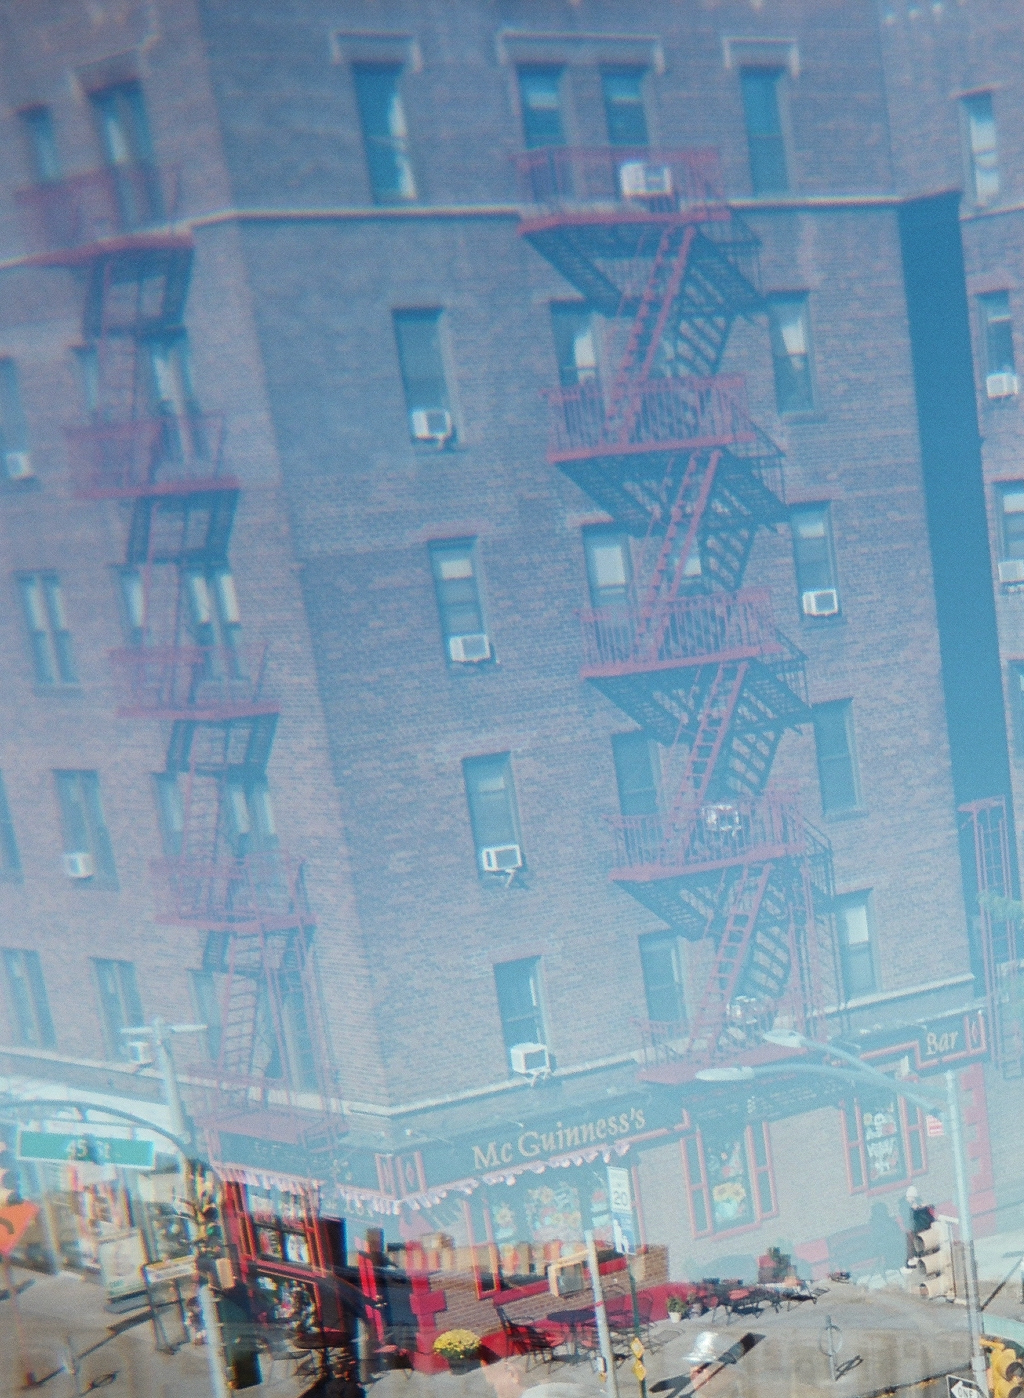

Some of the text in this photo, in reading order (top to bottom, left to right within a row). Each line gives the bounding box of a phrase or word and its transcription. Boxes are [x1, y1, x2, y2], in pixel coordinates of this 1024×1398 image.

[925, 1030, 959, 1055] Bar
[66, 1139, 89, 1161] 45
[613, 1190, 629, 1207] 20
